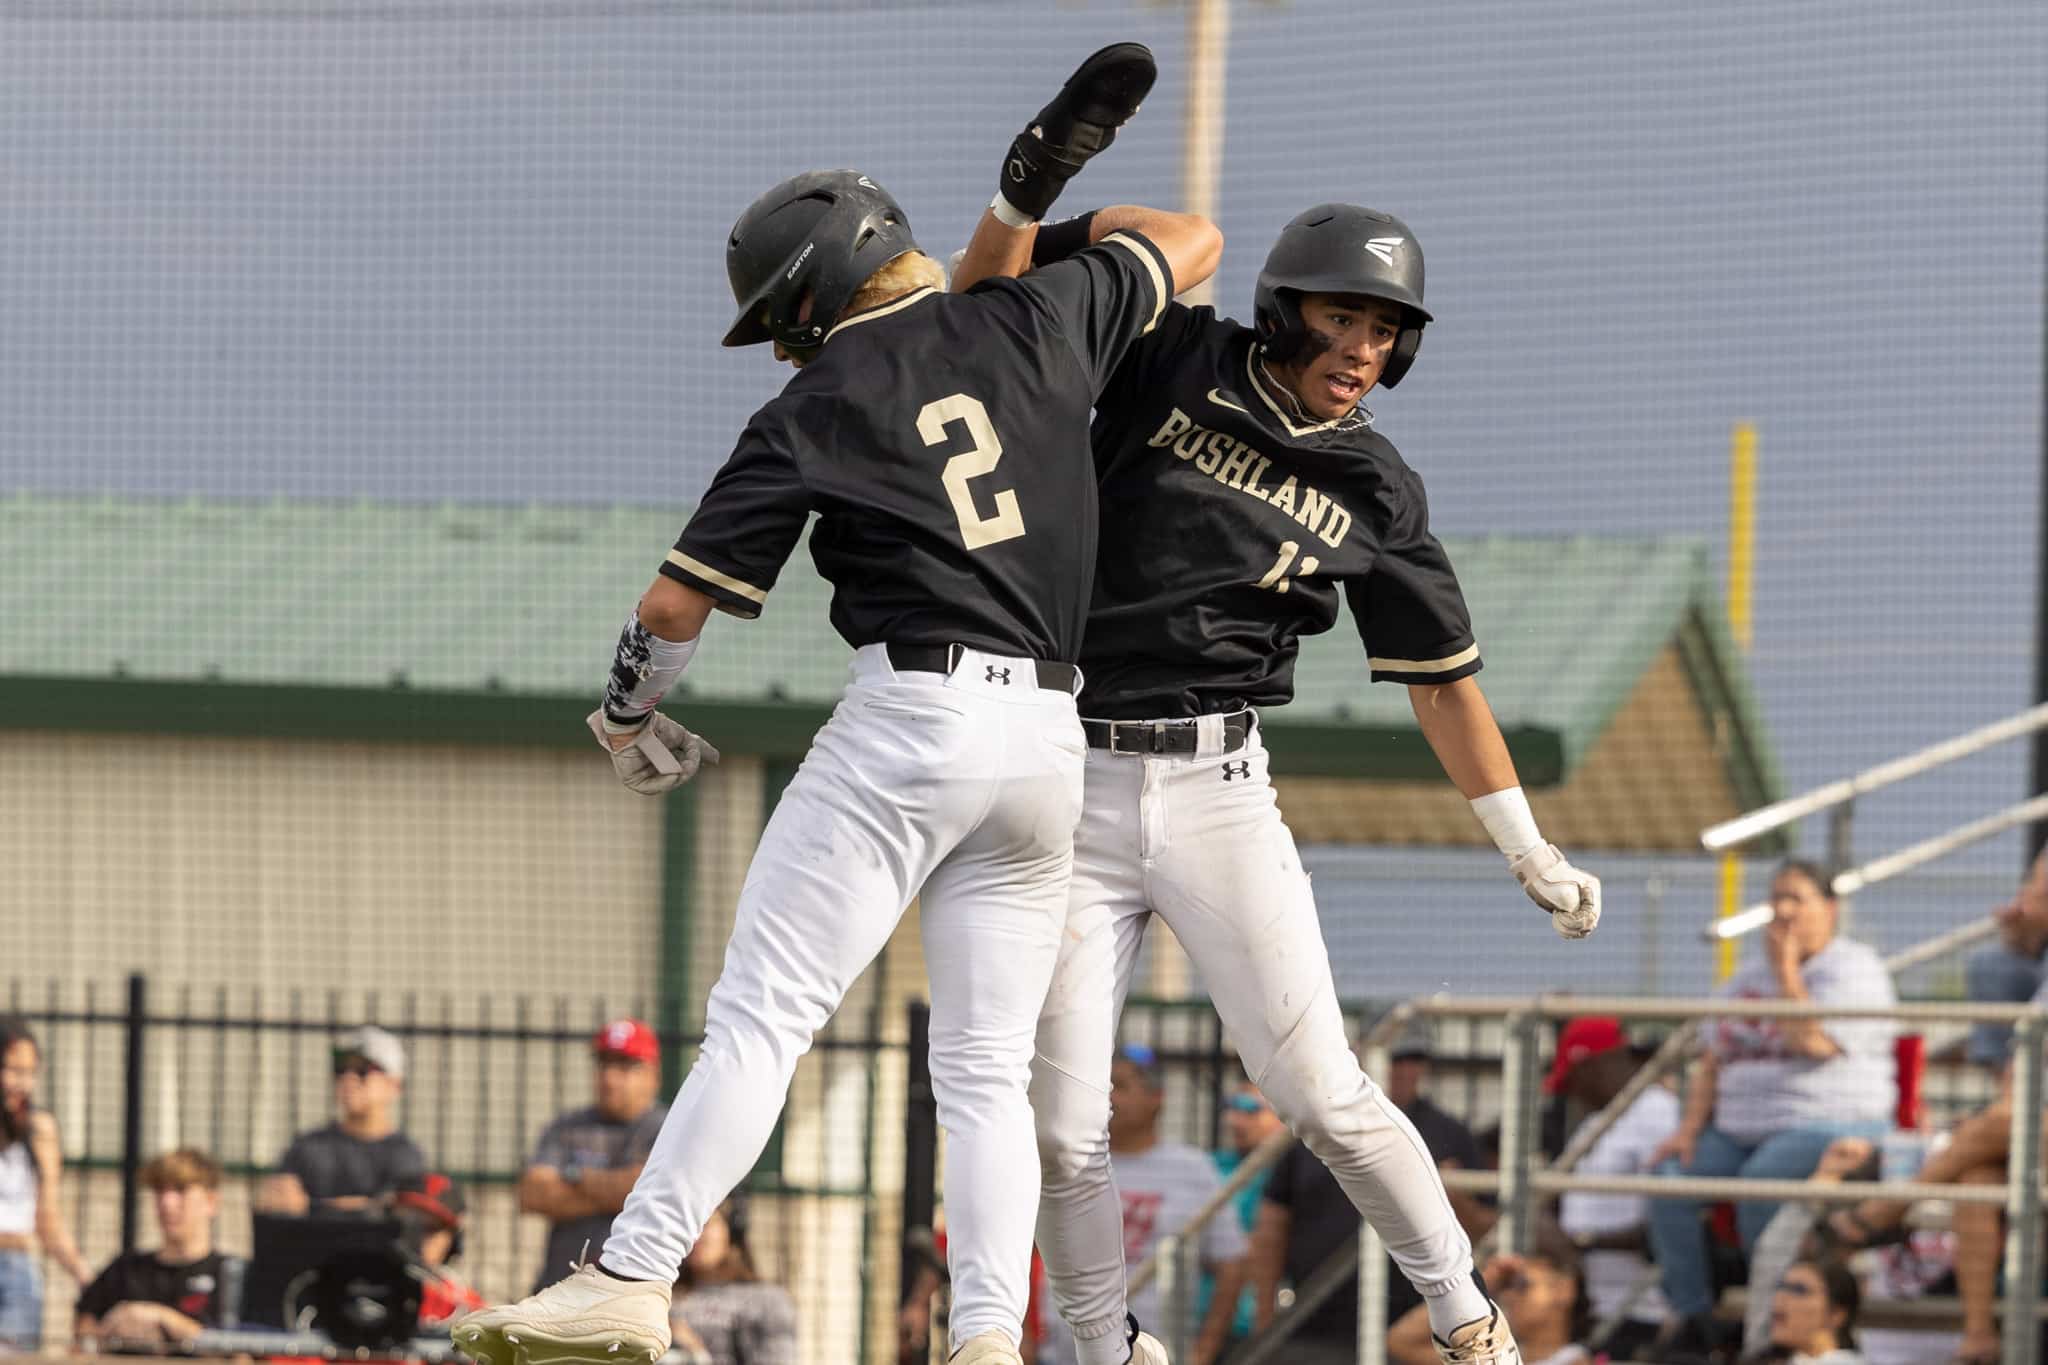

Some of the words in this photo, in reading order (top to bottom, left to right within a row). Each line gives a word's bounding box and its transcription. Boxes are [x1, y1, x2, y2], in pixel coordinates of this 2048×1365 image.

[787, 242, 814, 280] EASTON
[915, 392, 1026, 551] 2
[1147, 407, 1352, 549] BUSHLAND
